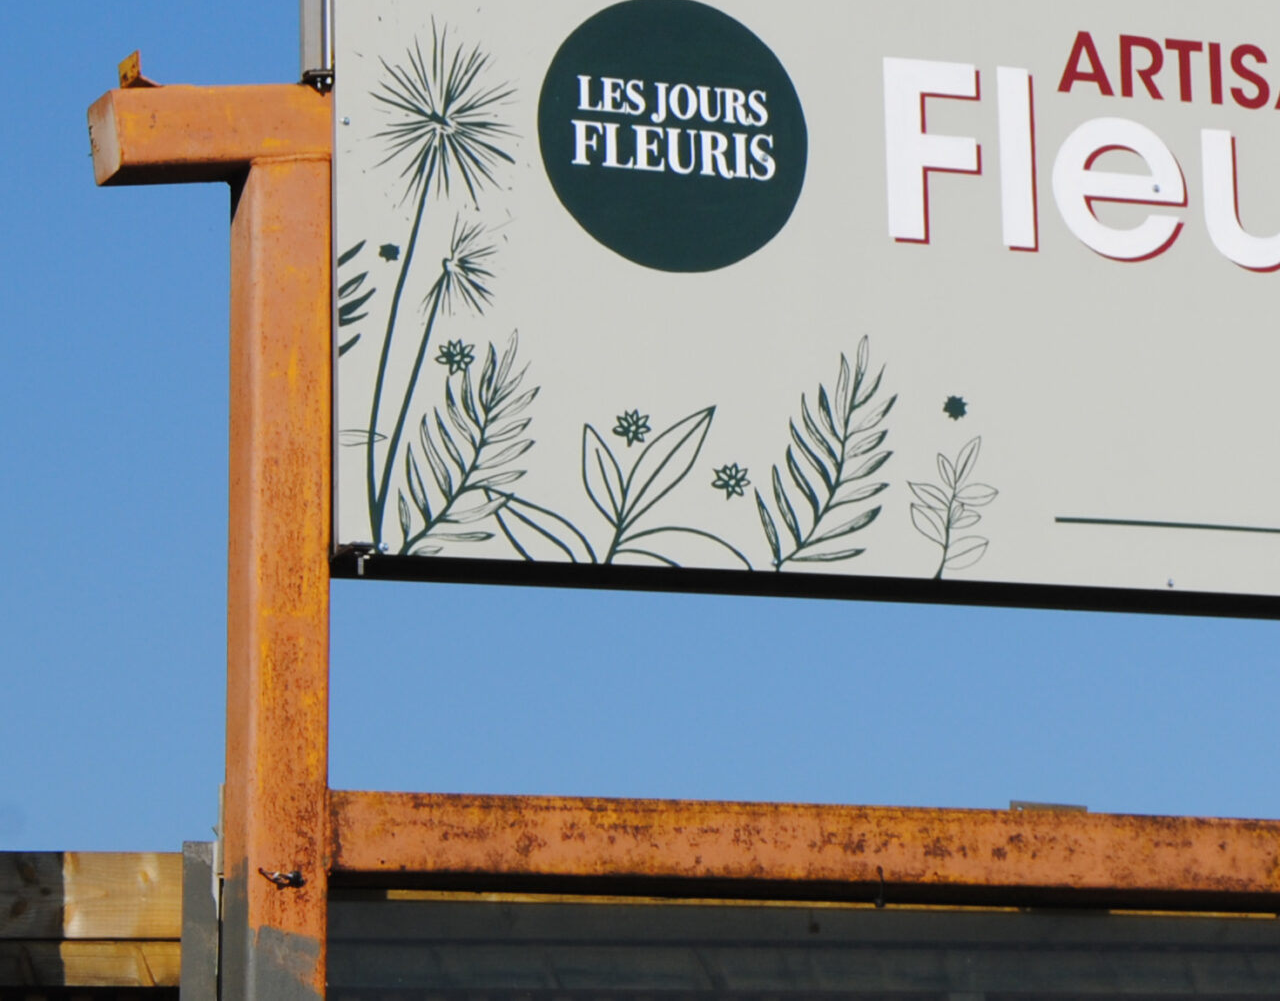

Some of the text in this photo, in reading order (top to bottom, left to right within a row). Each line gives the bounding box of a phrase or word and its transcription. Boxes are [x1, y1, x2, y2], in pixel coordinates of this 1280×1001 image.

[577, 74, 769, 127] LES JOURS
[571, 119, 776, 181] FLEURIS
